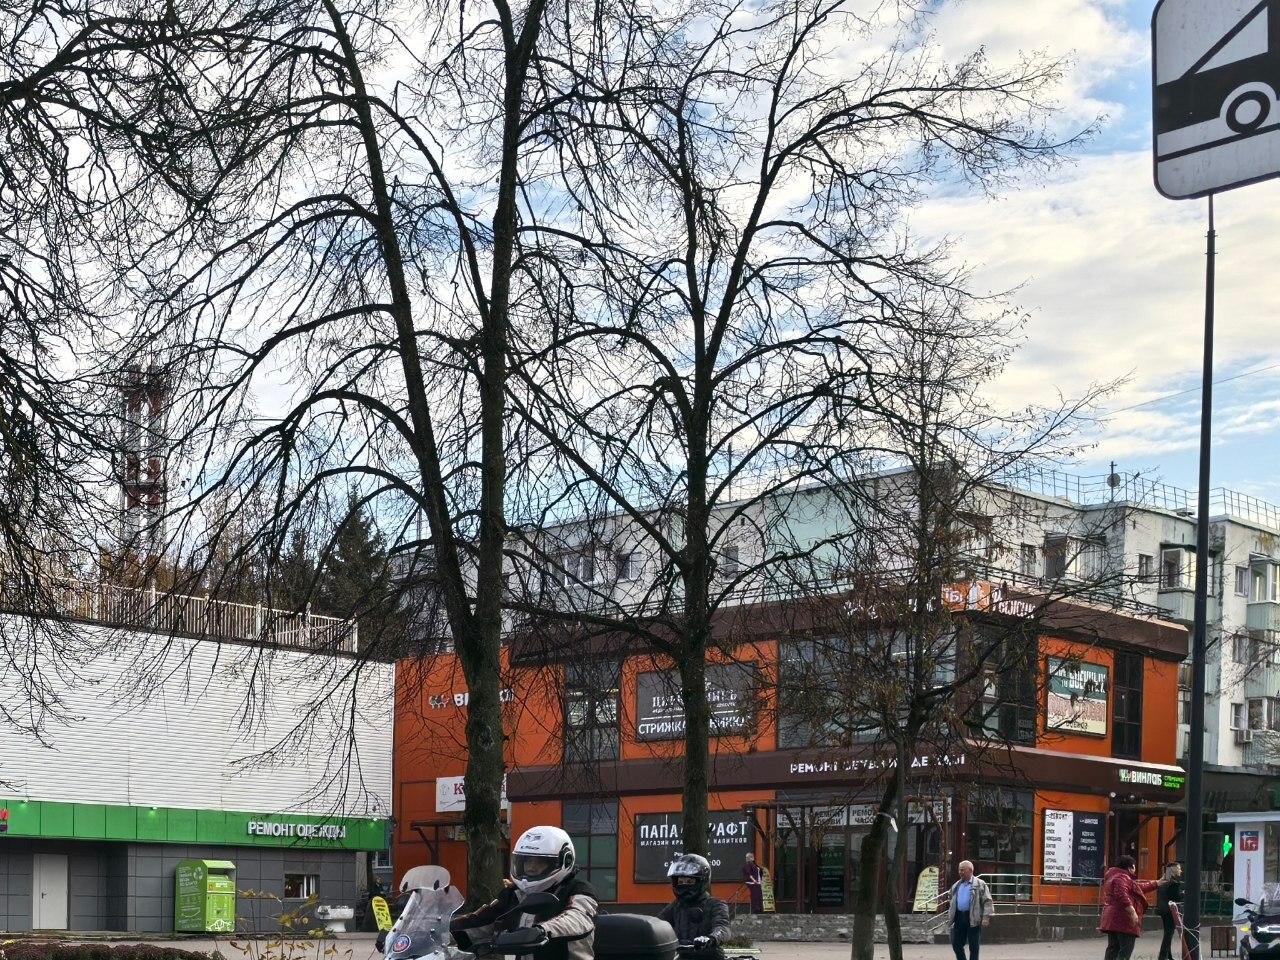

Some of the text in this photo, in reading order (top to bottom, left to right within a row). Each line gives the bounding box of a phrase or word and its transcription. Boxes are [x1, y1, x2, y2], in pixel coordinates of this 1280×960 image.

[247, 821, 296, 837] РЕМОНТ
[640, 821, 748, 840] ПАПА РАФТ
